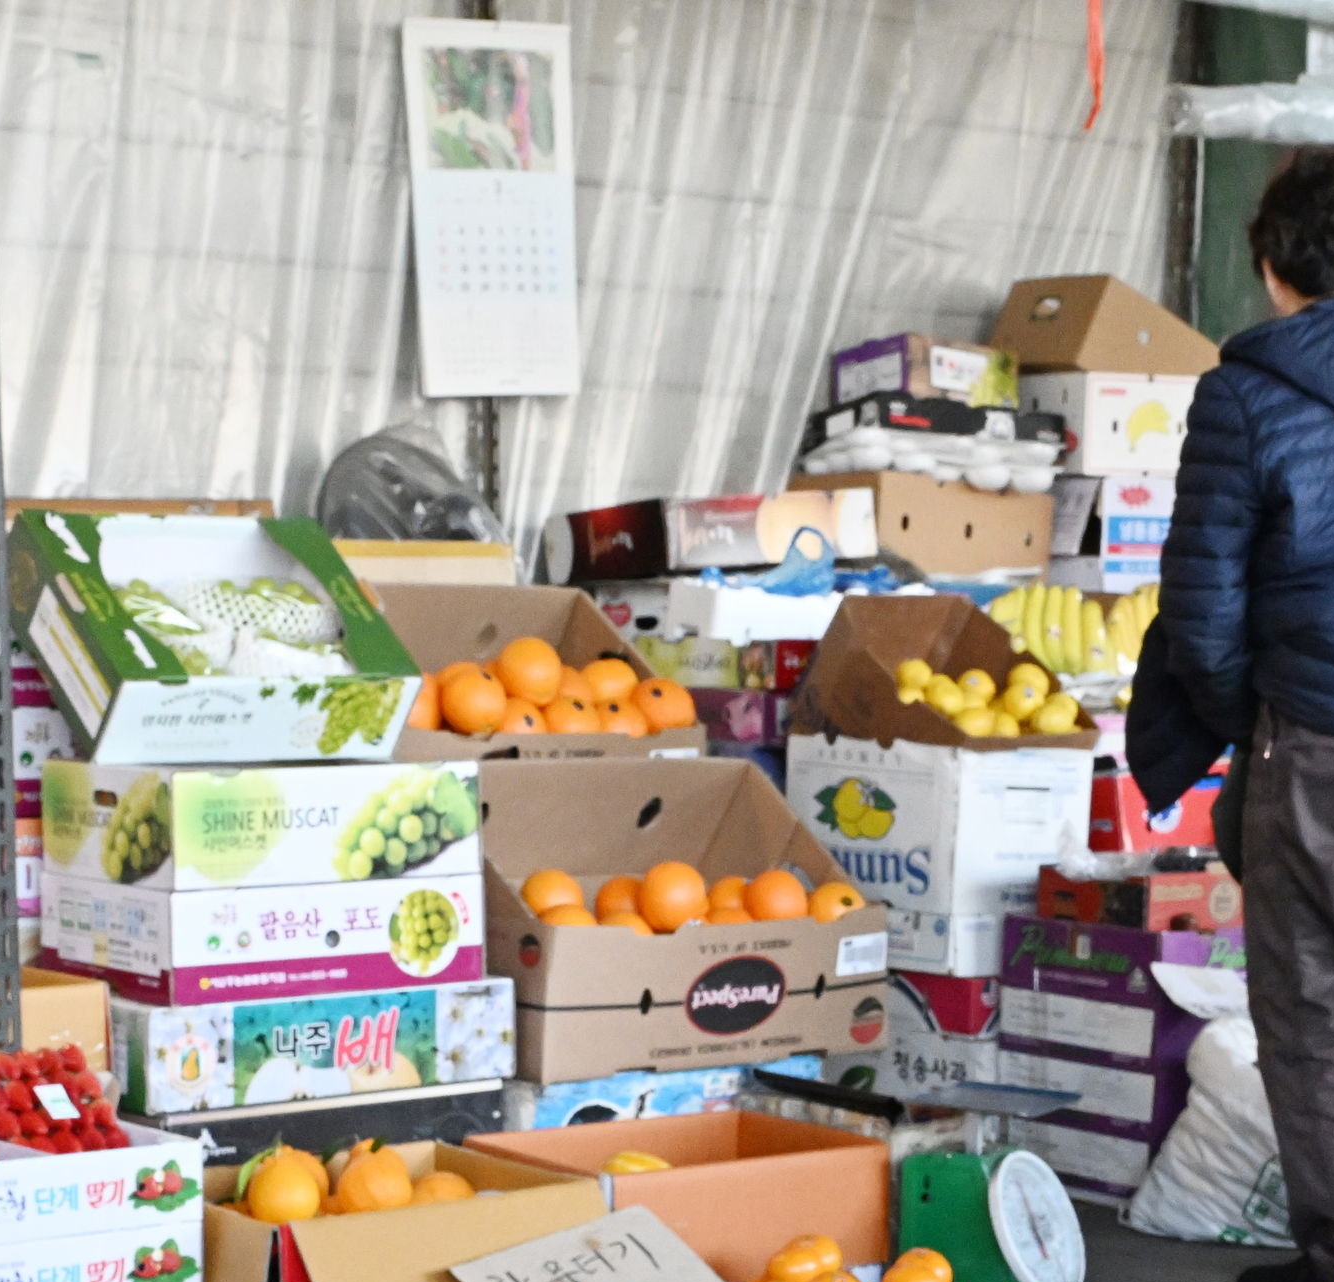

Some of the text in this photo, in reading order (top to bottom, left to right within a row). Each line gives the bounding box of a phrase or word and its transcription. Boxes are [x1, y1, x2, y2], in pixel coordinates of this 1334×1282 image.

[202, 807, 339, 834] SHINE MUSCAT
[260, 906, 383, 941] 팔음산 포도
[692, 983, 780, 1010] PureSpect
[273, 1006, 400, 1072] 나주 배
[35, 1184, 79, 1214] 단계
[87, 1179, 125, 1209] 딸기
